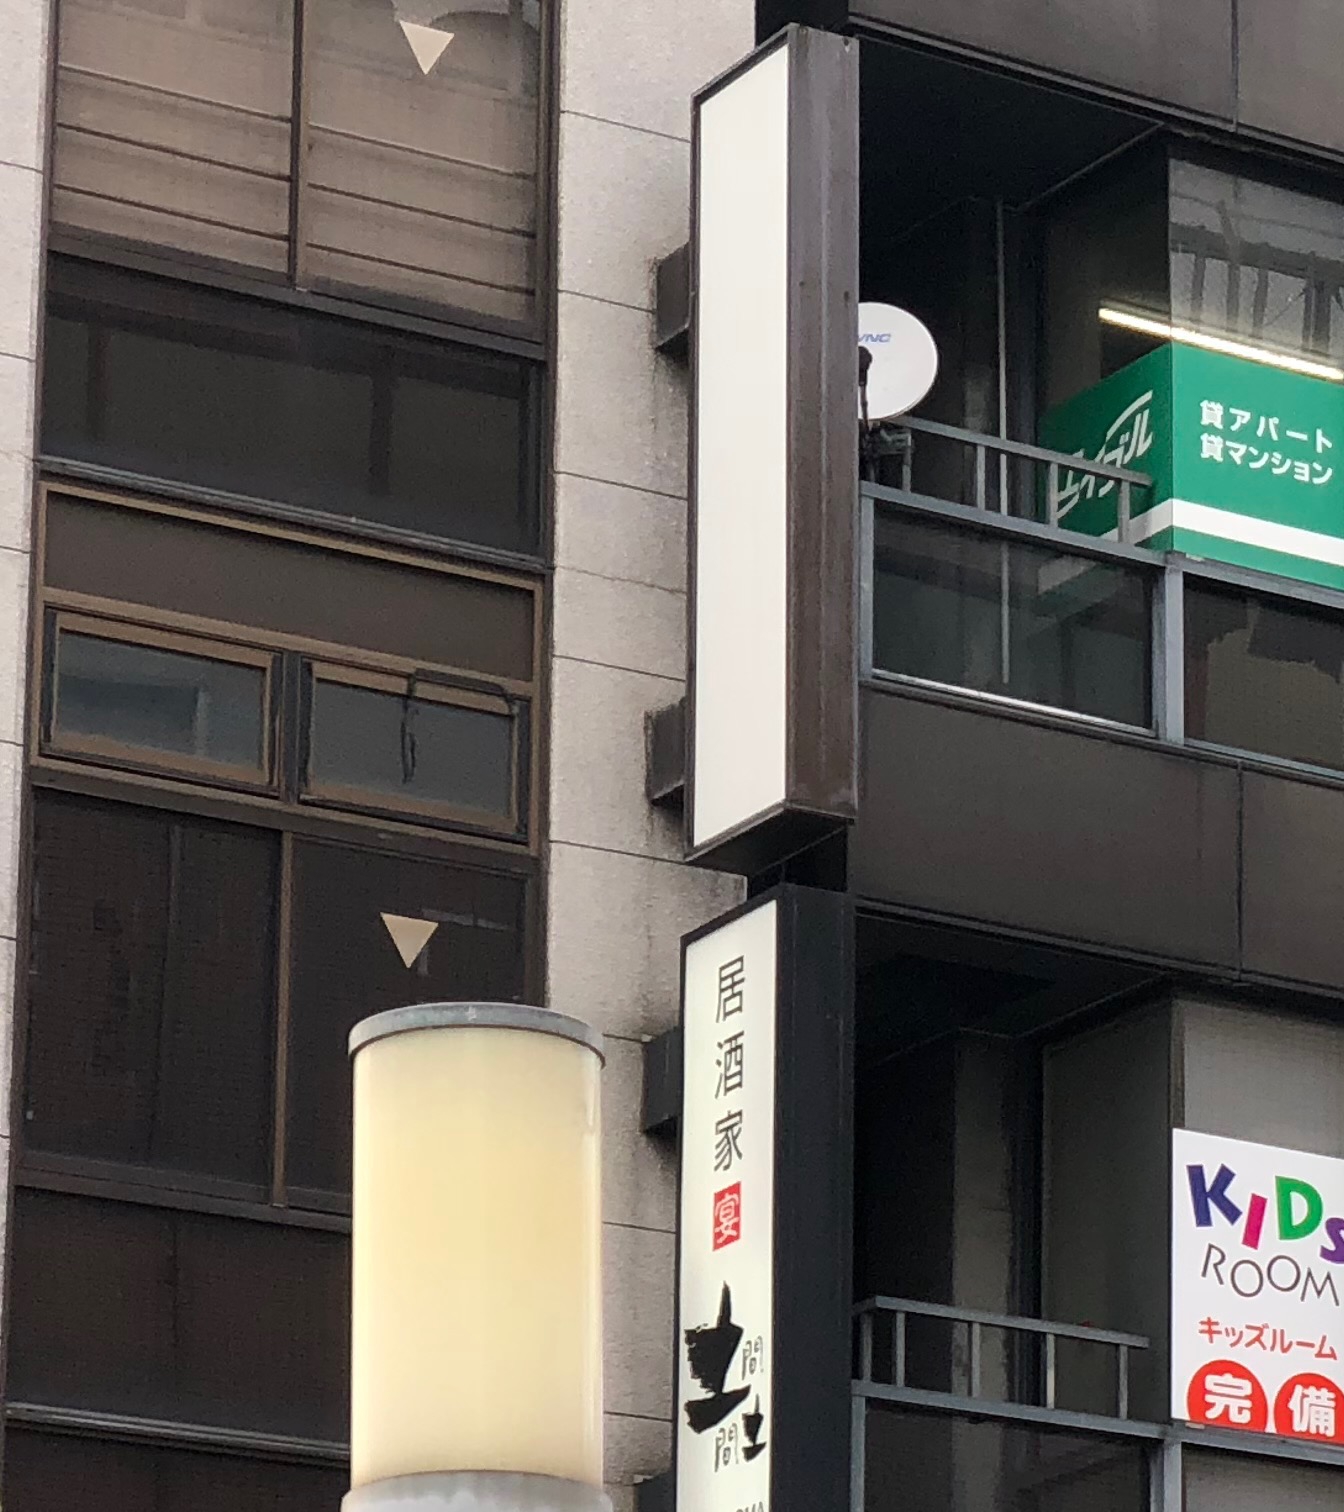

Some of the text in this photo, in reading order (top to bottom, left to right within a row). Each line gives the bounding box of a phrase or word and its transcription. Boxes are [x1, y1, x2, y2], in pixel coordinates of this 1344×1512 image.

[1199, 397, 1334, 453] 貸アパート
[1199, 431, 1334, 486] 貸マンション
[713, 954, 747, 1175] 居酒家
[1200, 1242, 1341, 1307] ROOM
[1197, 1316, 1339, 1361] キッズルーム
[1203, 1372, 1337, 1438] 完備
